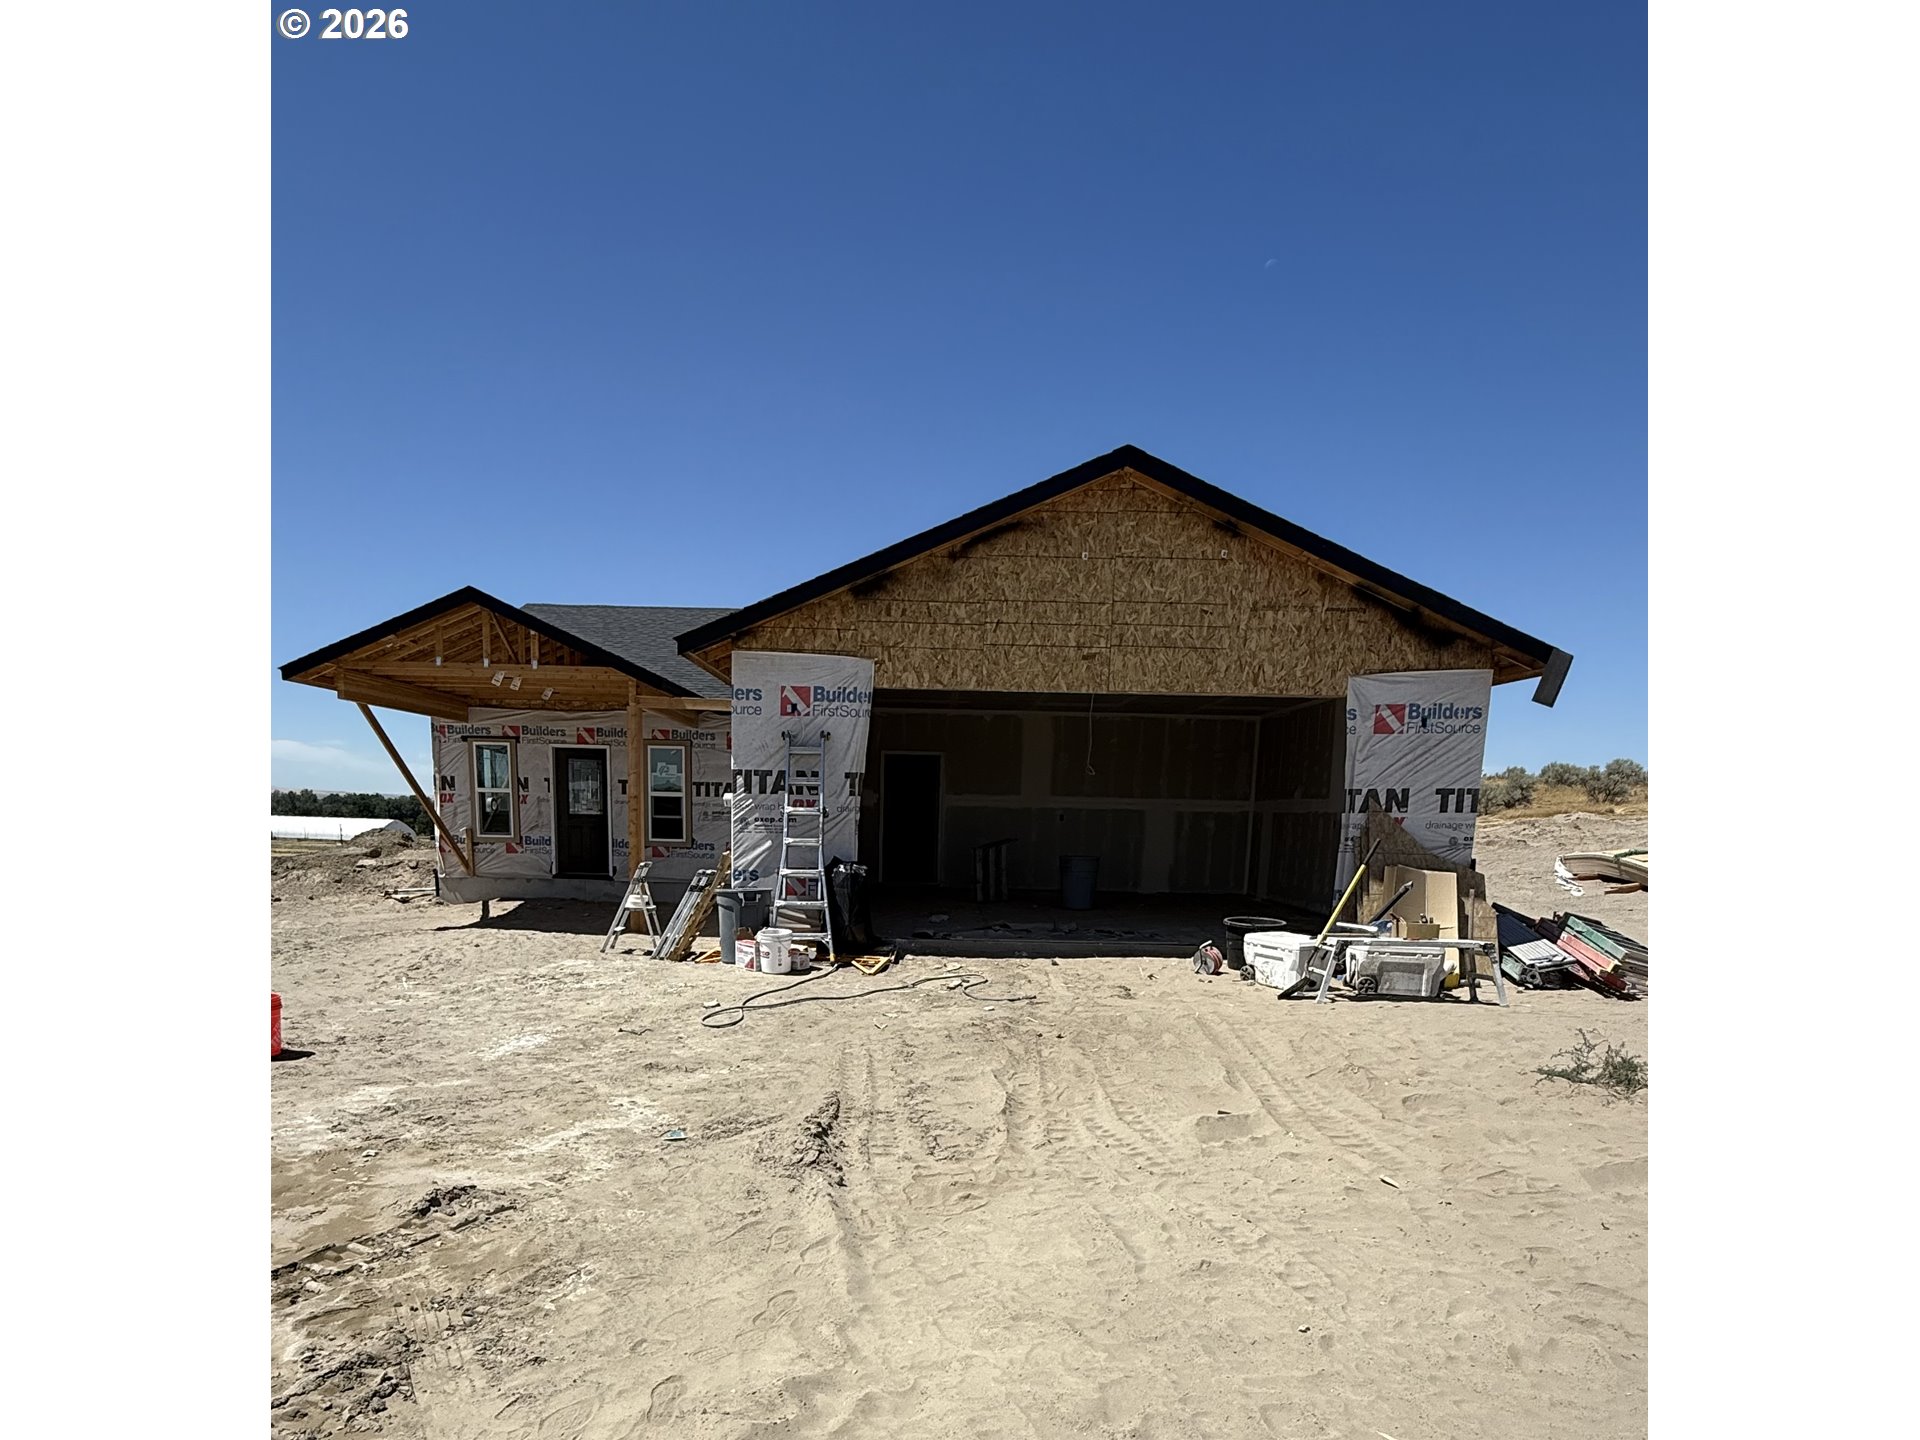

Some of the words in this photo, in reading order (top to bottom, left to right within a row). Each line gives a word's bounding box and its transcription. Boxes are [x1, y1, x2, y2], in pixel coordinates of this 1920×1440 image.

[1407, 702, 1483, 720] Builders
[446, 724, 492, 735] Builders
[521, 725, 567, 737] Builders
[1406, 721, 1481, 735] FirstSource
[670, 729, 716, 741] Builders
[1424, 820, 1464, 832] drainage
